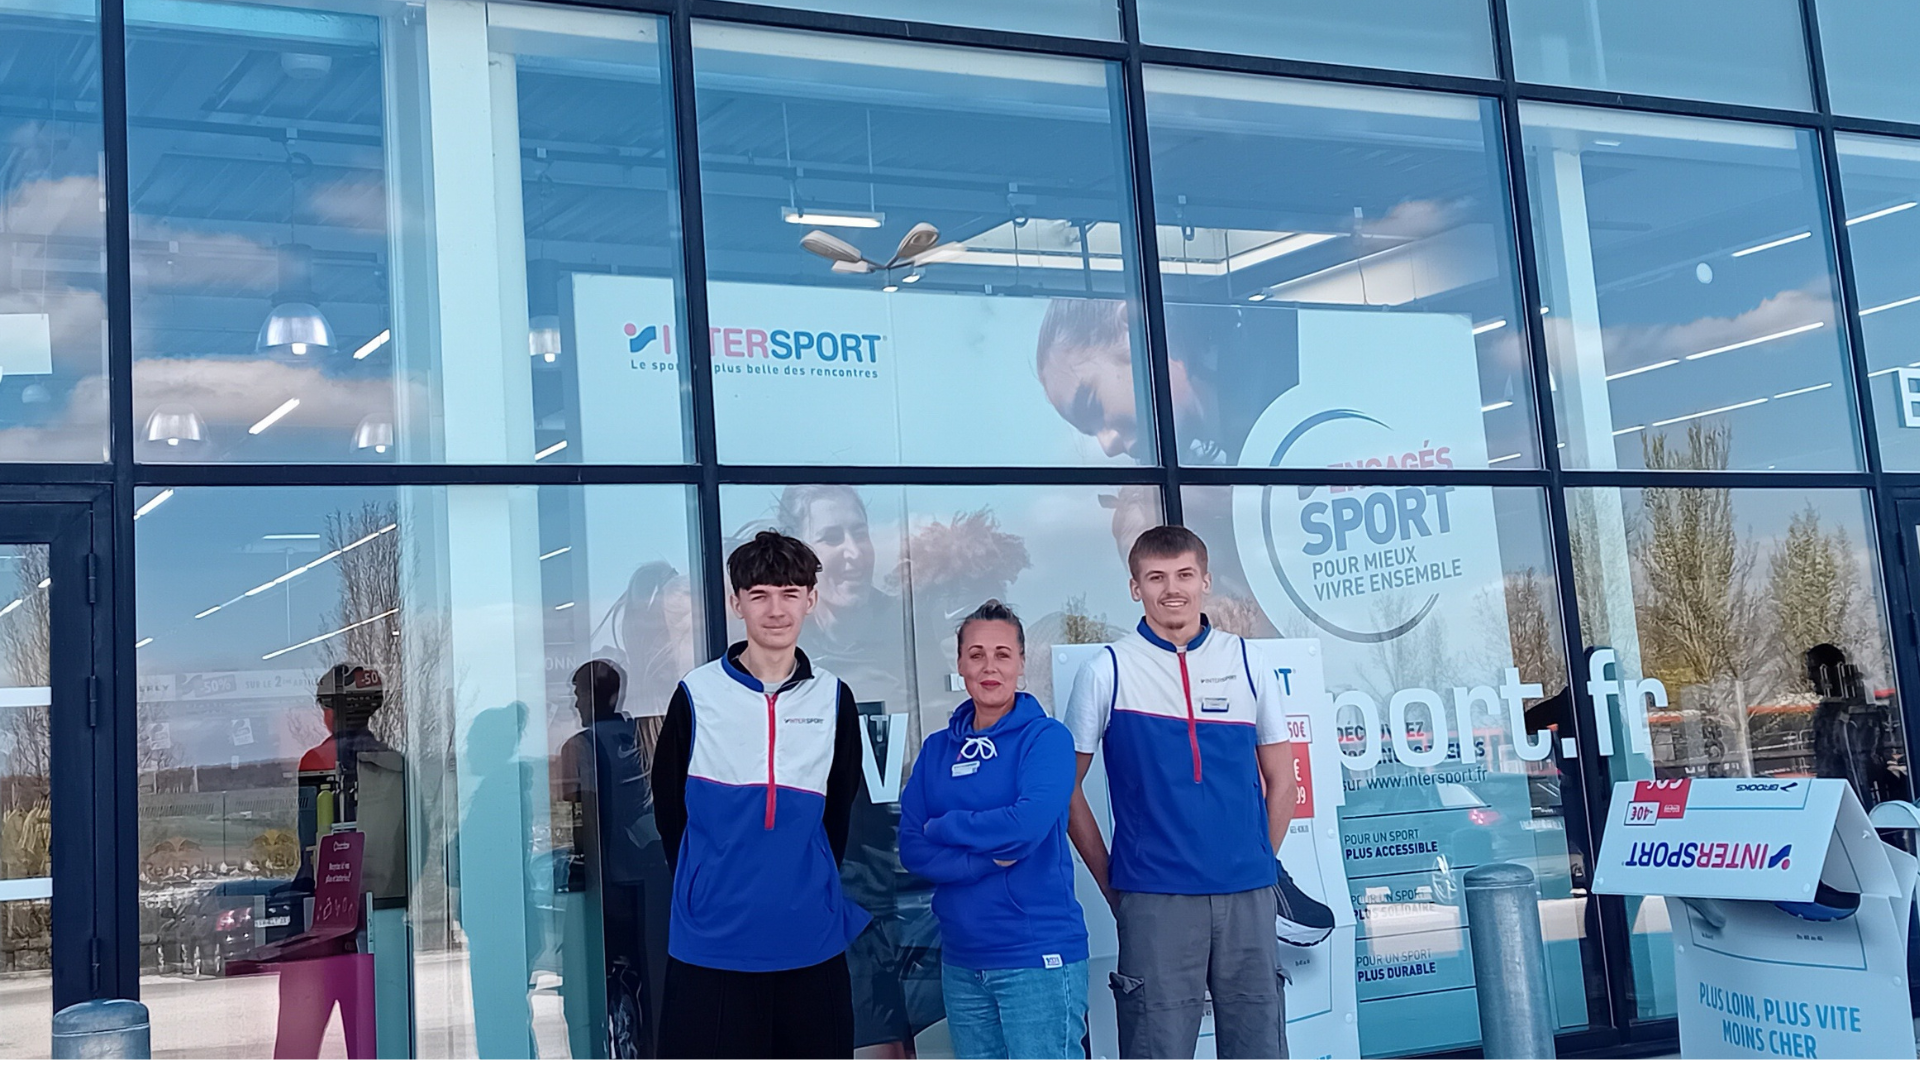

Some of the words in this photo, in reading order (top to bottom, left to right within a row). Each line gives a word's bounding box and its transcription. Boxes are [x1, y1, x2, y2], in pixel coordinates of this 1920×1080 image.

[663, 325, 881, 363] ITERSPORT
[631, 359, 646, 370] Le
[652, 361, 678, 374] spo
[714, 364, 741, 375] plus
[747, 364, 779, 375] belle
[784, 365, 806, 376] des
[811, 367, 878, 378] rencontres
[1301, 486, 1455, 556] SPORT
[1312, 556, 1359, 580] POUR
[1364, 545, 1417, 571] MIEUX
[1314, 576, 1365, 601] VIVRE
[1370, 558, 1462, 592] ENSEMBLE
[1367, 766, 1487, 789] www.intersport.fr
[1735, 783, 1780, 793] BROOKS
[1630, 806, 1653, 821] -40€
[1344, 833, 1371, 845] POUR
[1373, 831, 1387, 843] UN
[1389, 829, 1419, 841] SPORT
[1346, 847, 1373, 860] PLUS
[1375, 841, 1438, 857] ACCESSIBLE
[1625, 842, 1769, 870] INTERSPORT
[1357, 955, 1383, 968] POUR
[1385, 953, 1400, 964] UN
[1402, 948, 1432, 962] SPORT
[1358, 969, 1385, 982] PLUS
[1388, 962, 1436, 978] DURABLE
[1699, 981, 1724, 1011] PLUS
[1725, 990, 1761, 1023] LOIN,
[1763, 998, 1811, 1028] PLUS
[1815, 1004, 1862, 1033] VITE
[1722, 1019, 1765, 1052] MOINS
[1769, 1030, 1818, 1059] CHER
